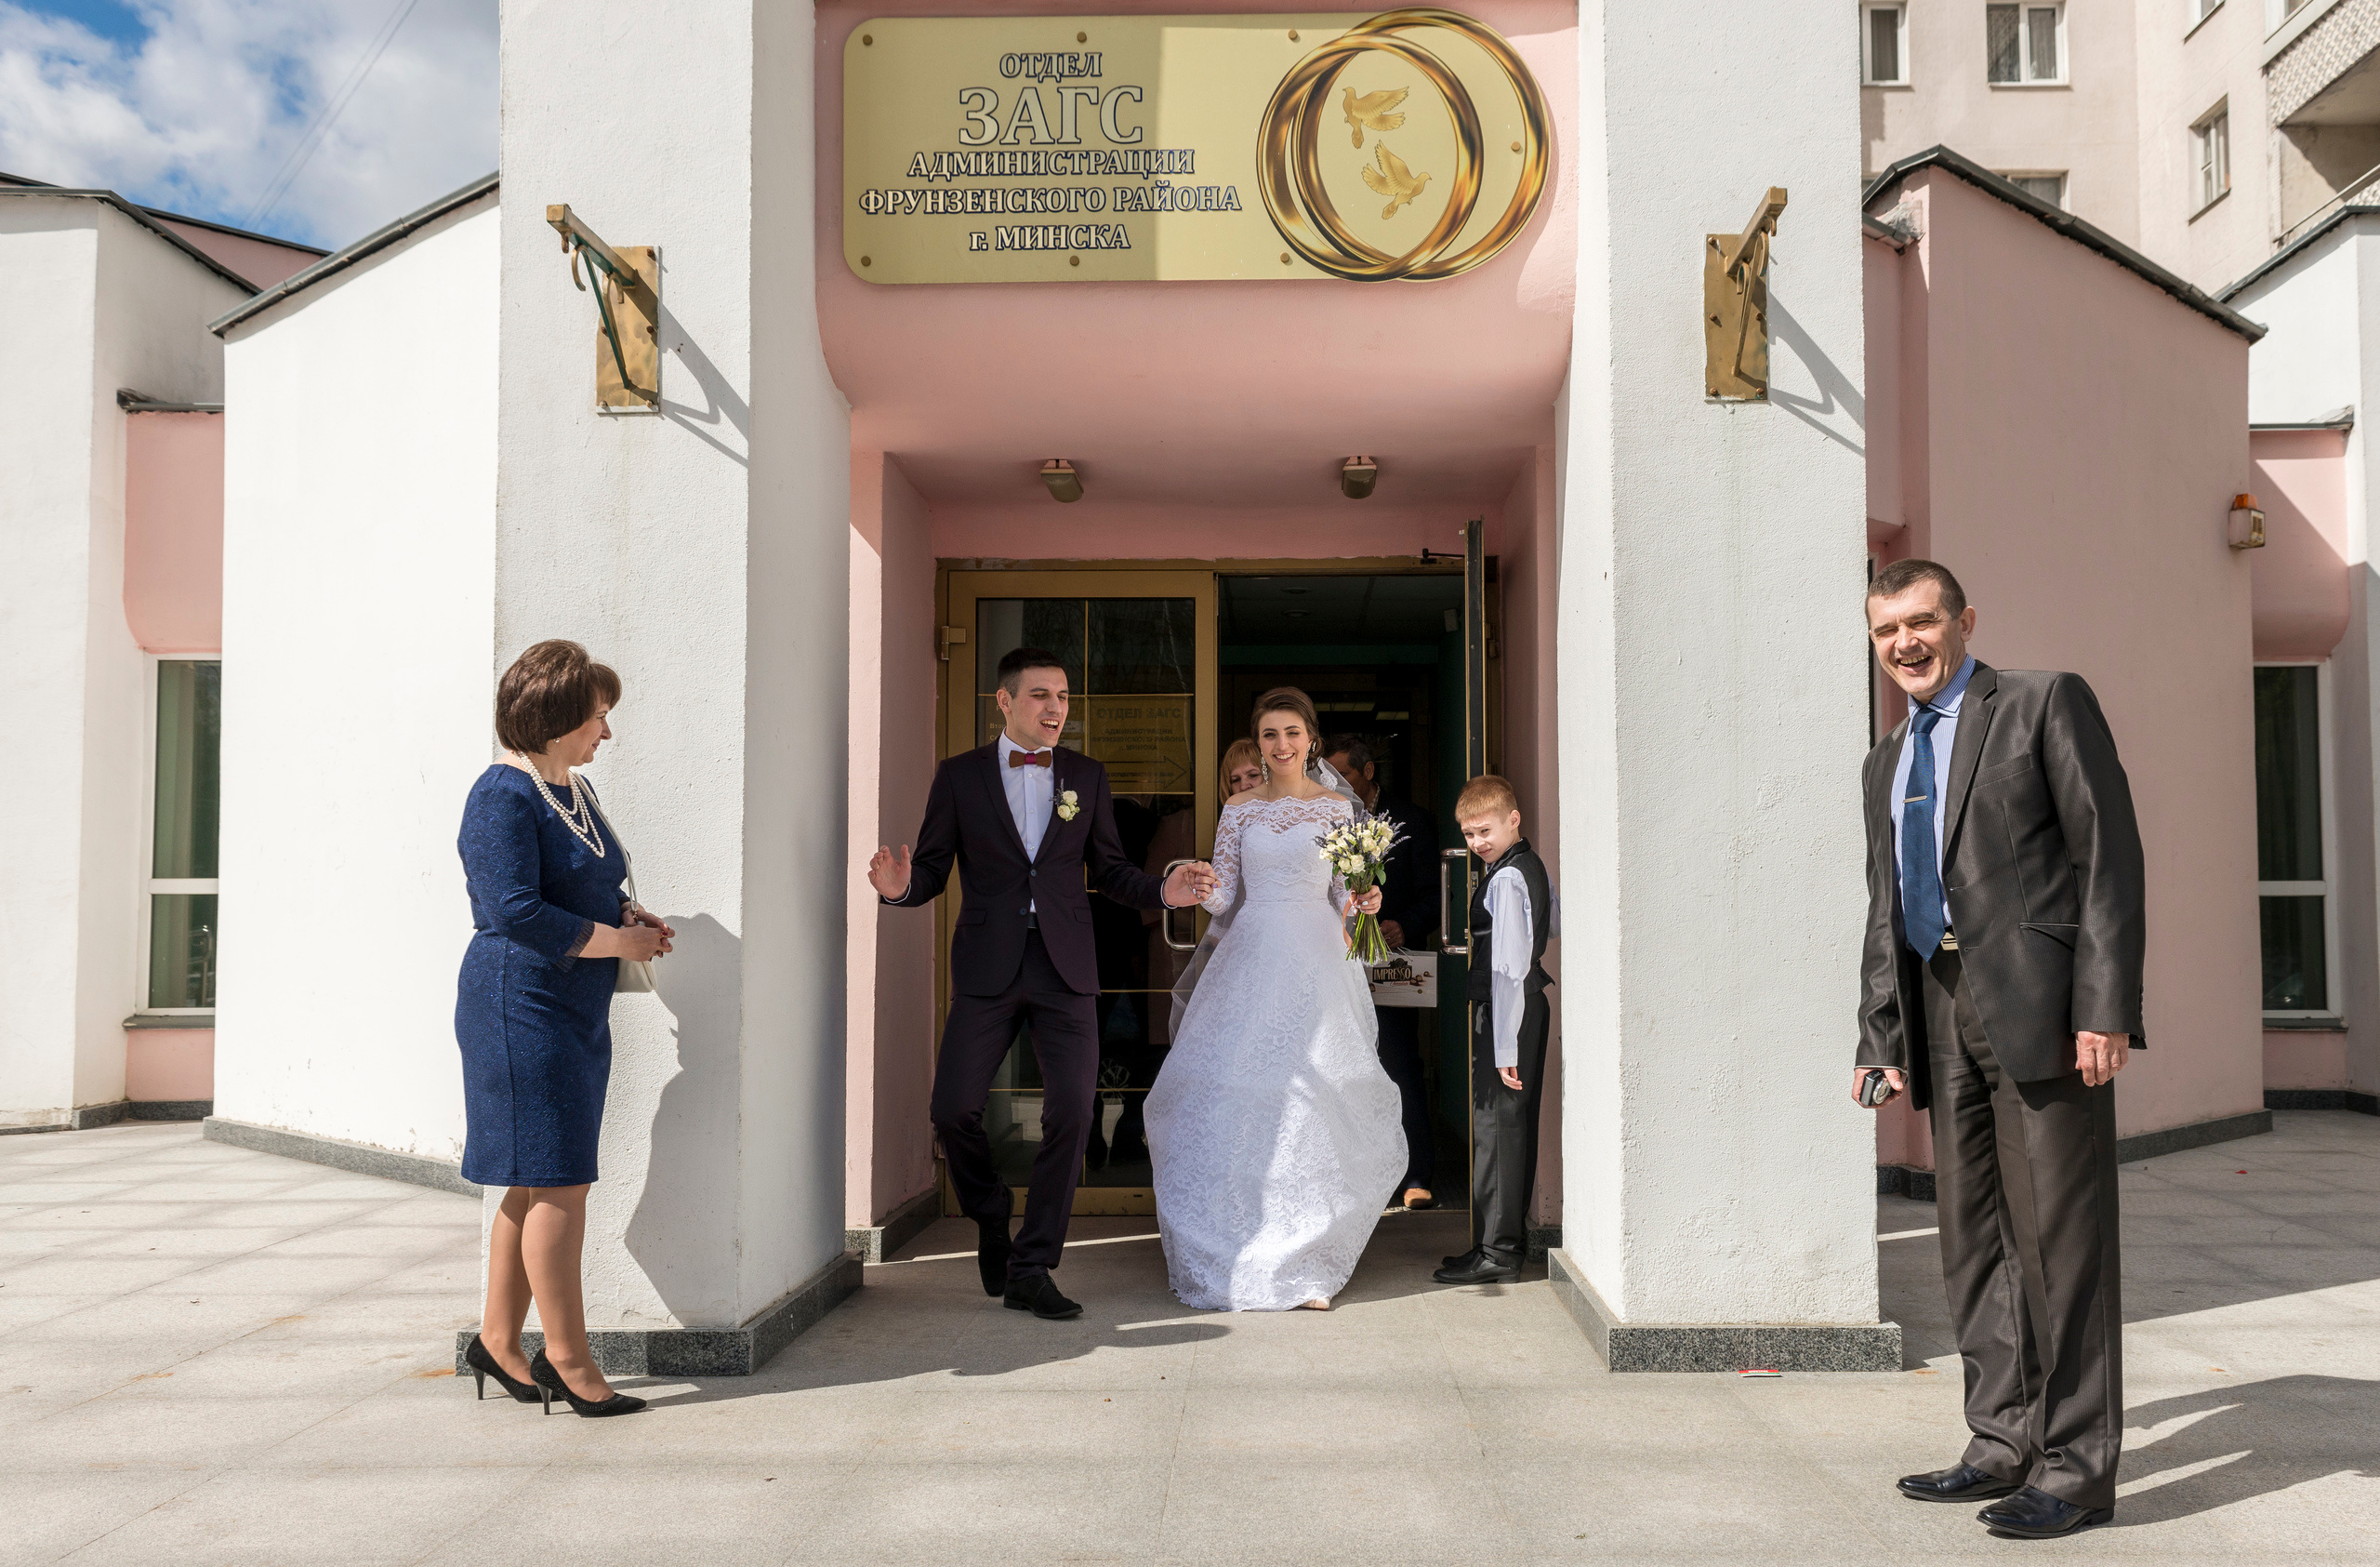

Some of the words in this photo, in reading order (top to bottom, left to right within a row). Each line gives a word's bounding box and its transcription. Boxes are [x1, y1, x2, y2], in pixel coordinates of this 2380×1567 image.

[999, 52, 1103, 83] ОТДЕЛ
[959, 85, 1144, 146] ЗАГС
[906, 149, 1196, 181] АДМИНИСТРАЦИИ
[858, 187, 1106, 215] ФРУНЗЕНСКОГО
[1113, 180, 1243, 212] РАЙОНА
[970, 231, 989, 251] г.
[995, 223, 1131, 250] МИНСКА
[1096, 708, 1143, 721] ОТДЕЛ
[1145, 708, 1181, 719] ЗАГС
[1373, 968, 1410, 981] IMPRESSO
